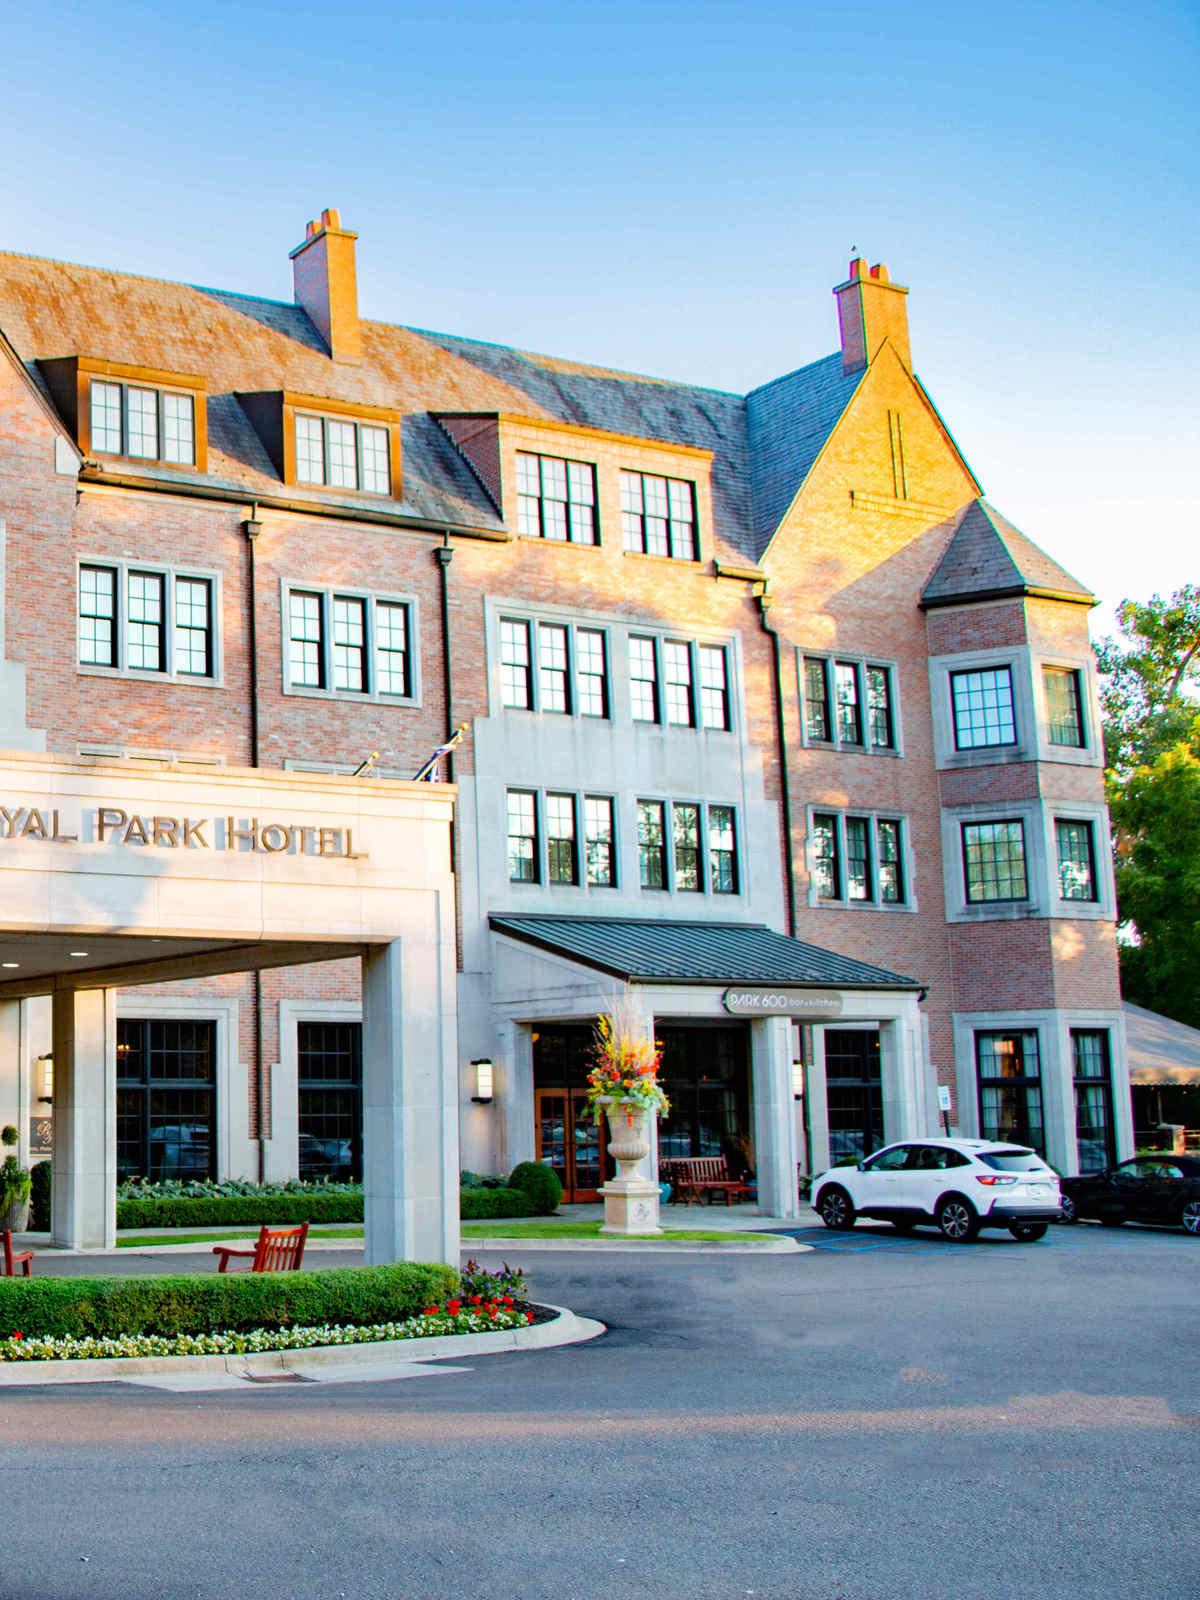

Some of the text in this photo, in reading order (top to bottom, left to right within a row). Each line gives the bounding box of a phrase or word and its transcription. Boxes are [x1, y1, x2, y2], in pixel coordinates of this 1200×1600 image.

[97, 807, 210, 848] PARK
[227, 815, 368, 860] HOTEL
[761, 994, 787, 1008] 600
